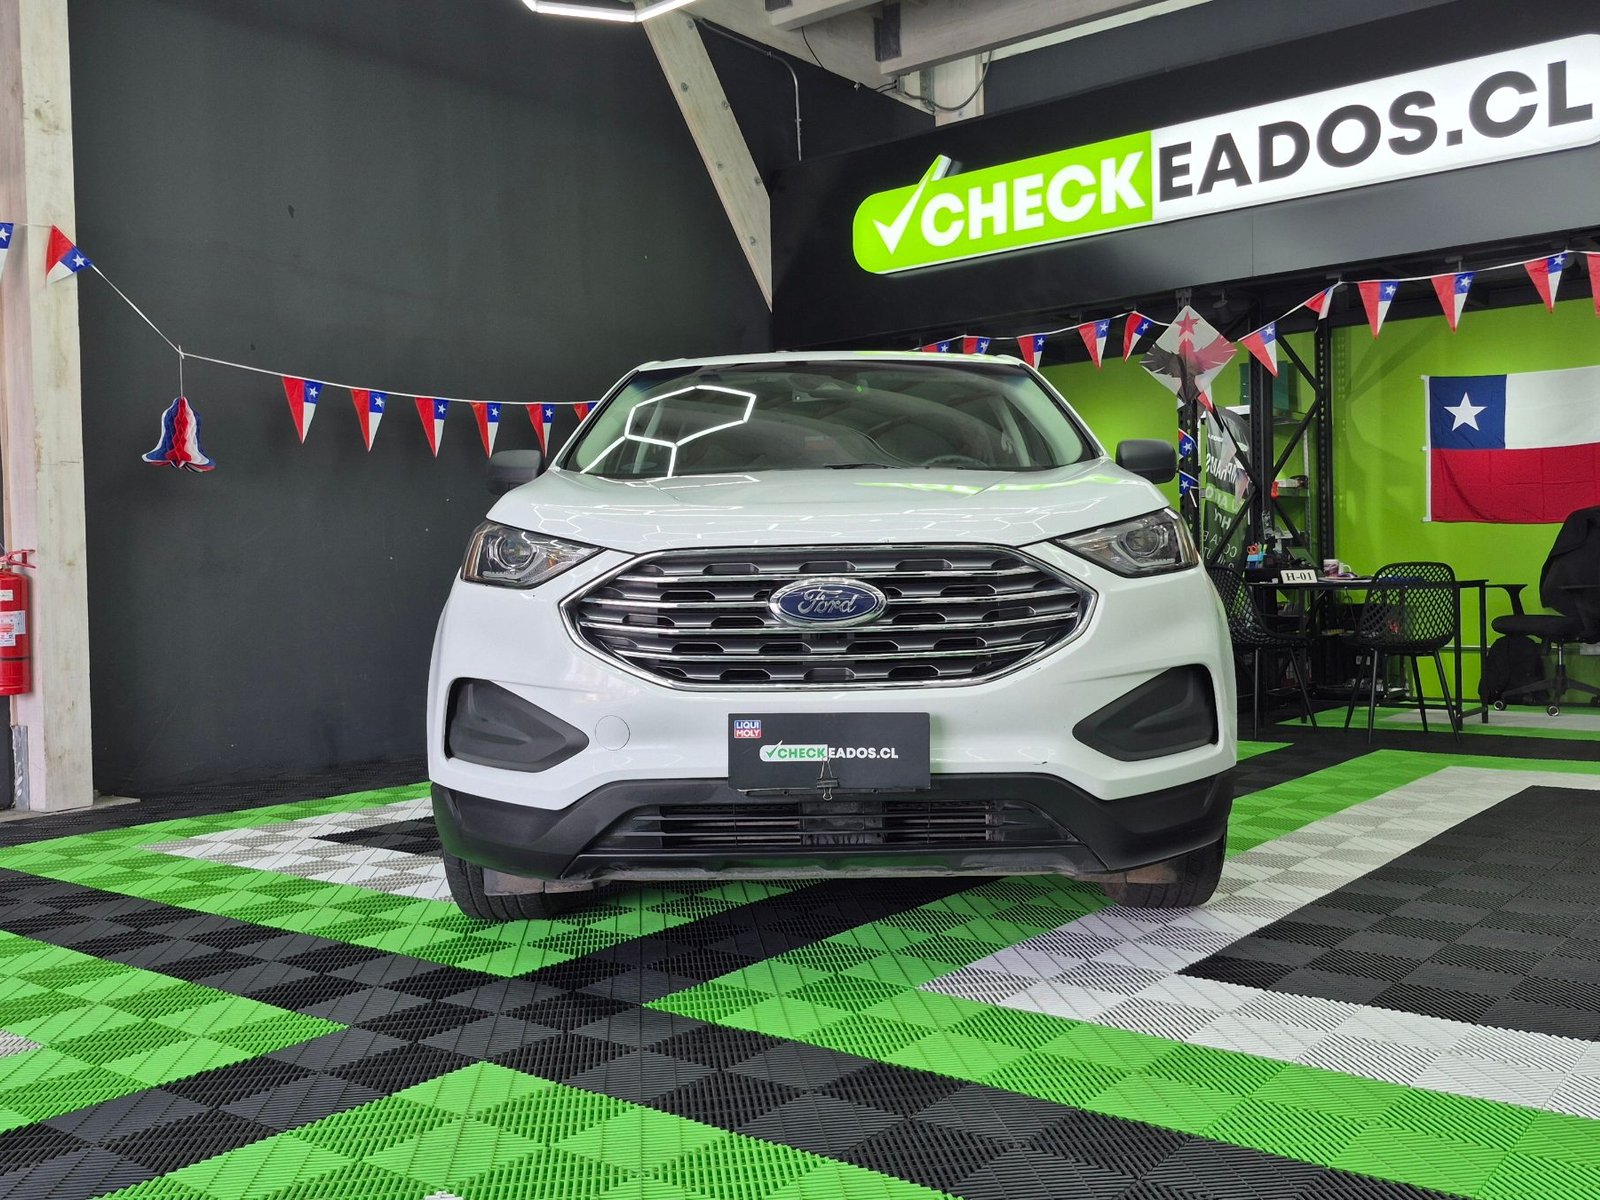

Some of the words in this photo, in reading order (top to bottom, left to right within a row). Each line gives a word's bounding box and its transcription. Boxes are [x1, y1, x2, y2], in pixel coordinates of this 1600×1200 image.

[920, 60, 1593, 247] CHECKEADOS.CL
[1286, 572, 1312, 581] H-01
[797, 586, 859, 614] Ford
[736, 721, 760, 730] LIQUI
[736, 730, 761, 738] MOLY
[777, 747, 899, 760] CHECKEADOS.CL
